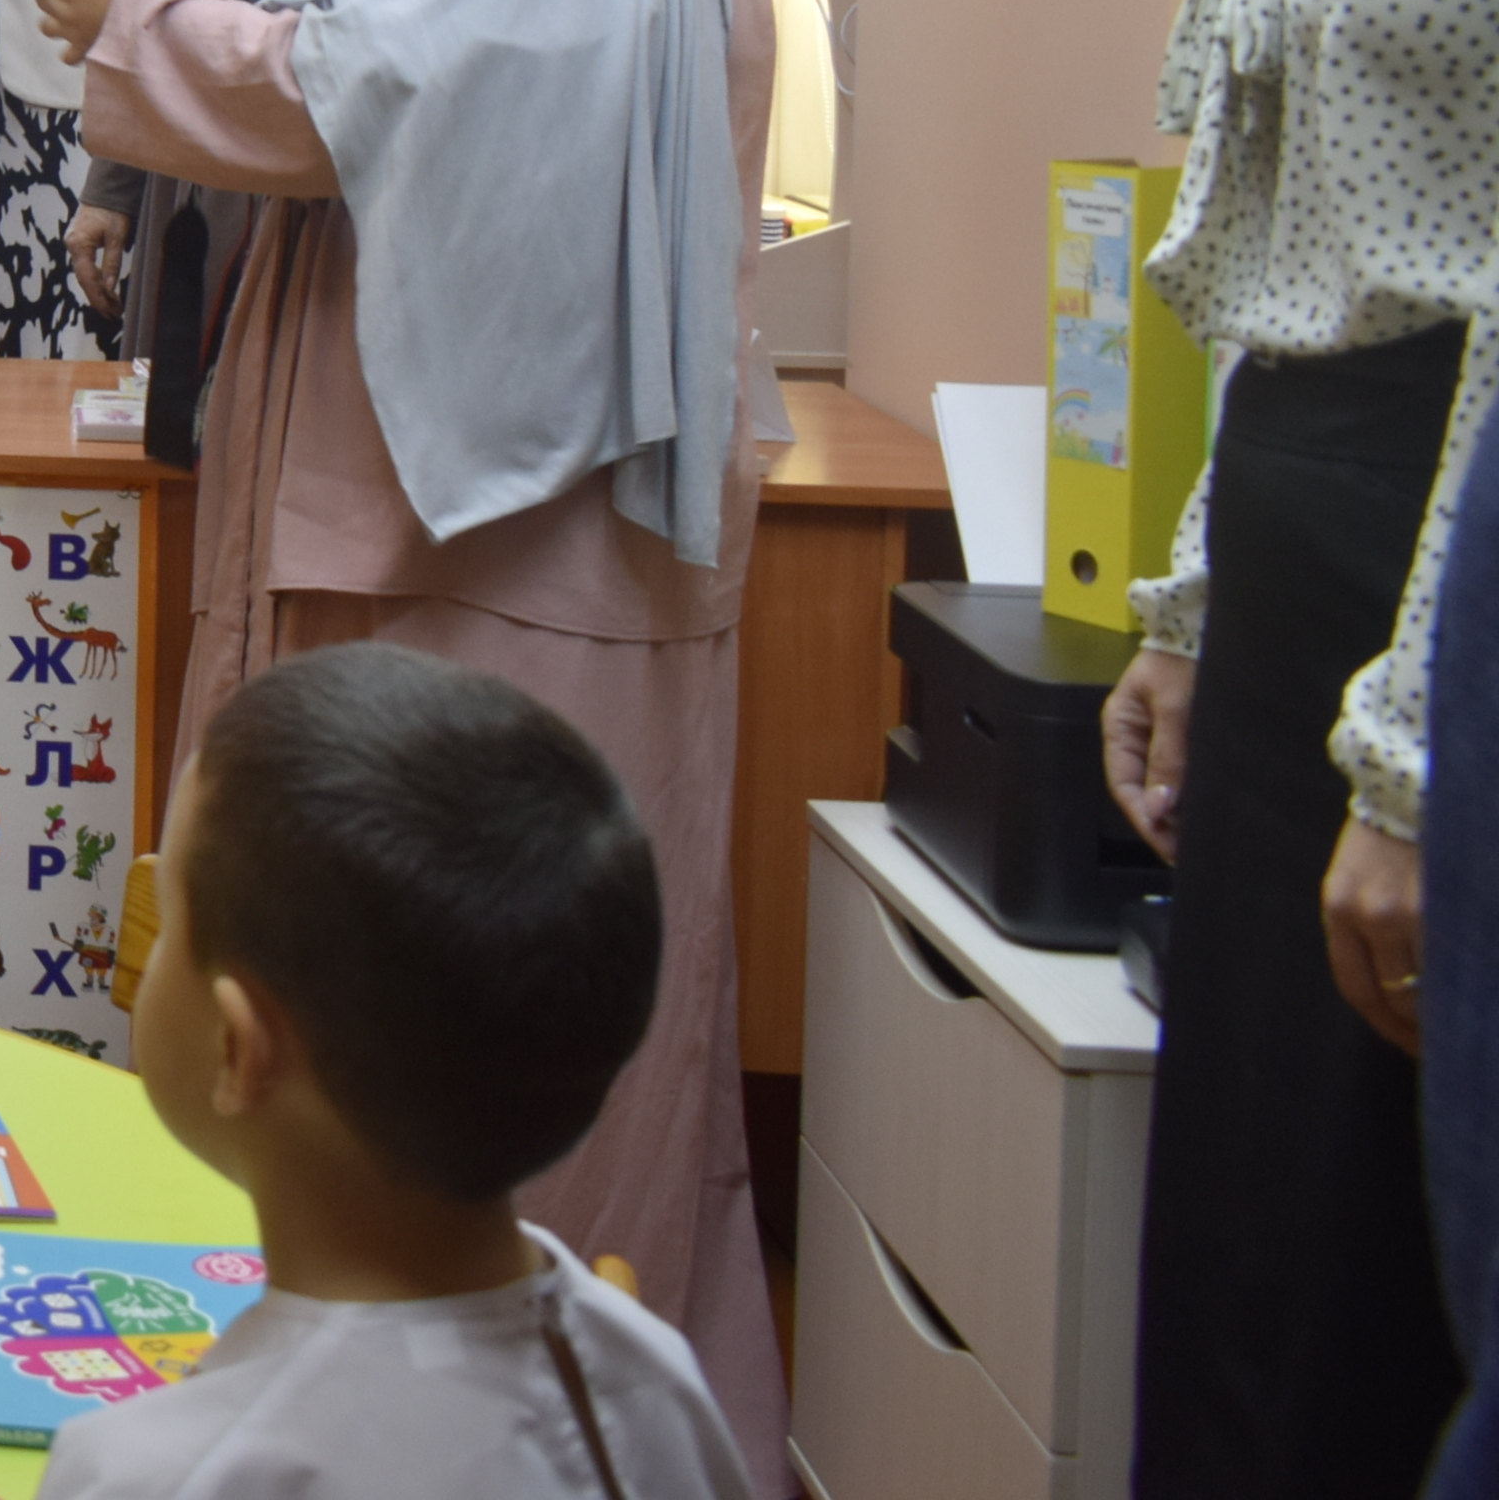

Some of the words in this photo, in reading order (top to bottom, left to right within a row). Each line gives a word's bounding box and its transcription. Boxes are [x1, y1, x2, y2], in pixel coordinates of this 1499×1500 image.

[48, 533, 89, 580] В
[7, 636, 76, 684] Ж
[25, 740, 72, 787] Л
[28, 845, 65, 890] Р
[31, 949, 77, 997] Х
